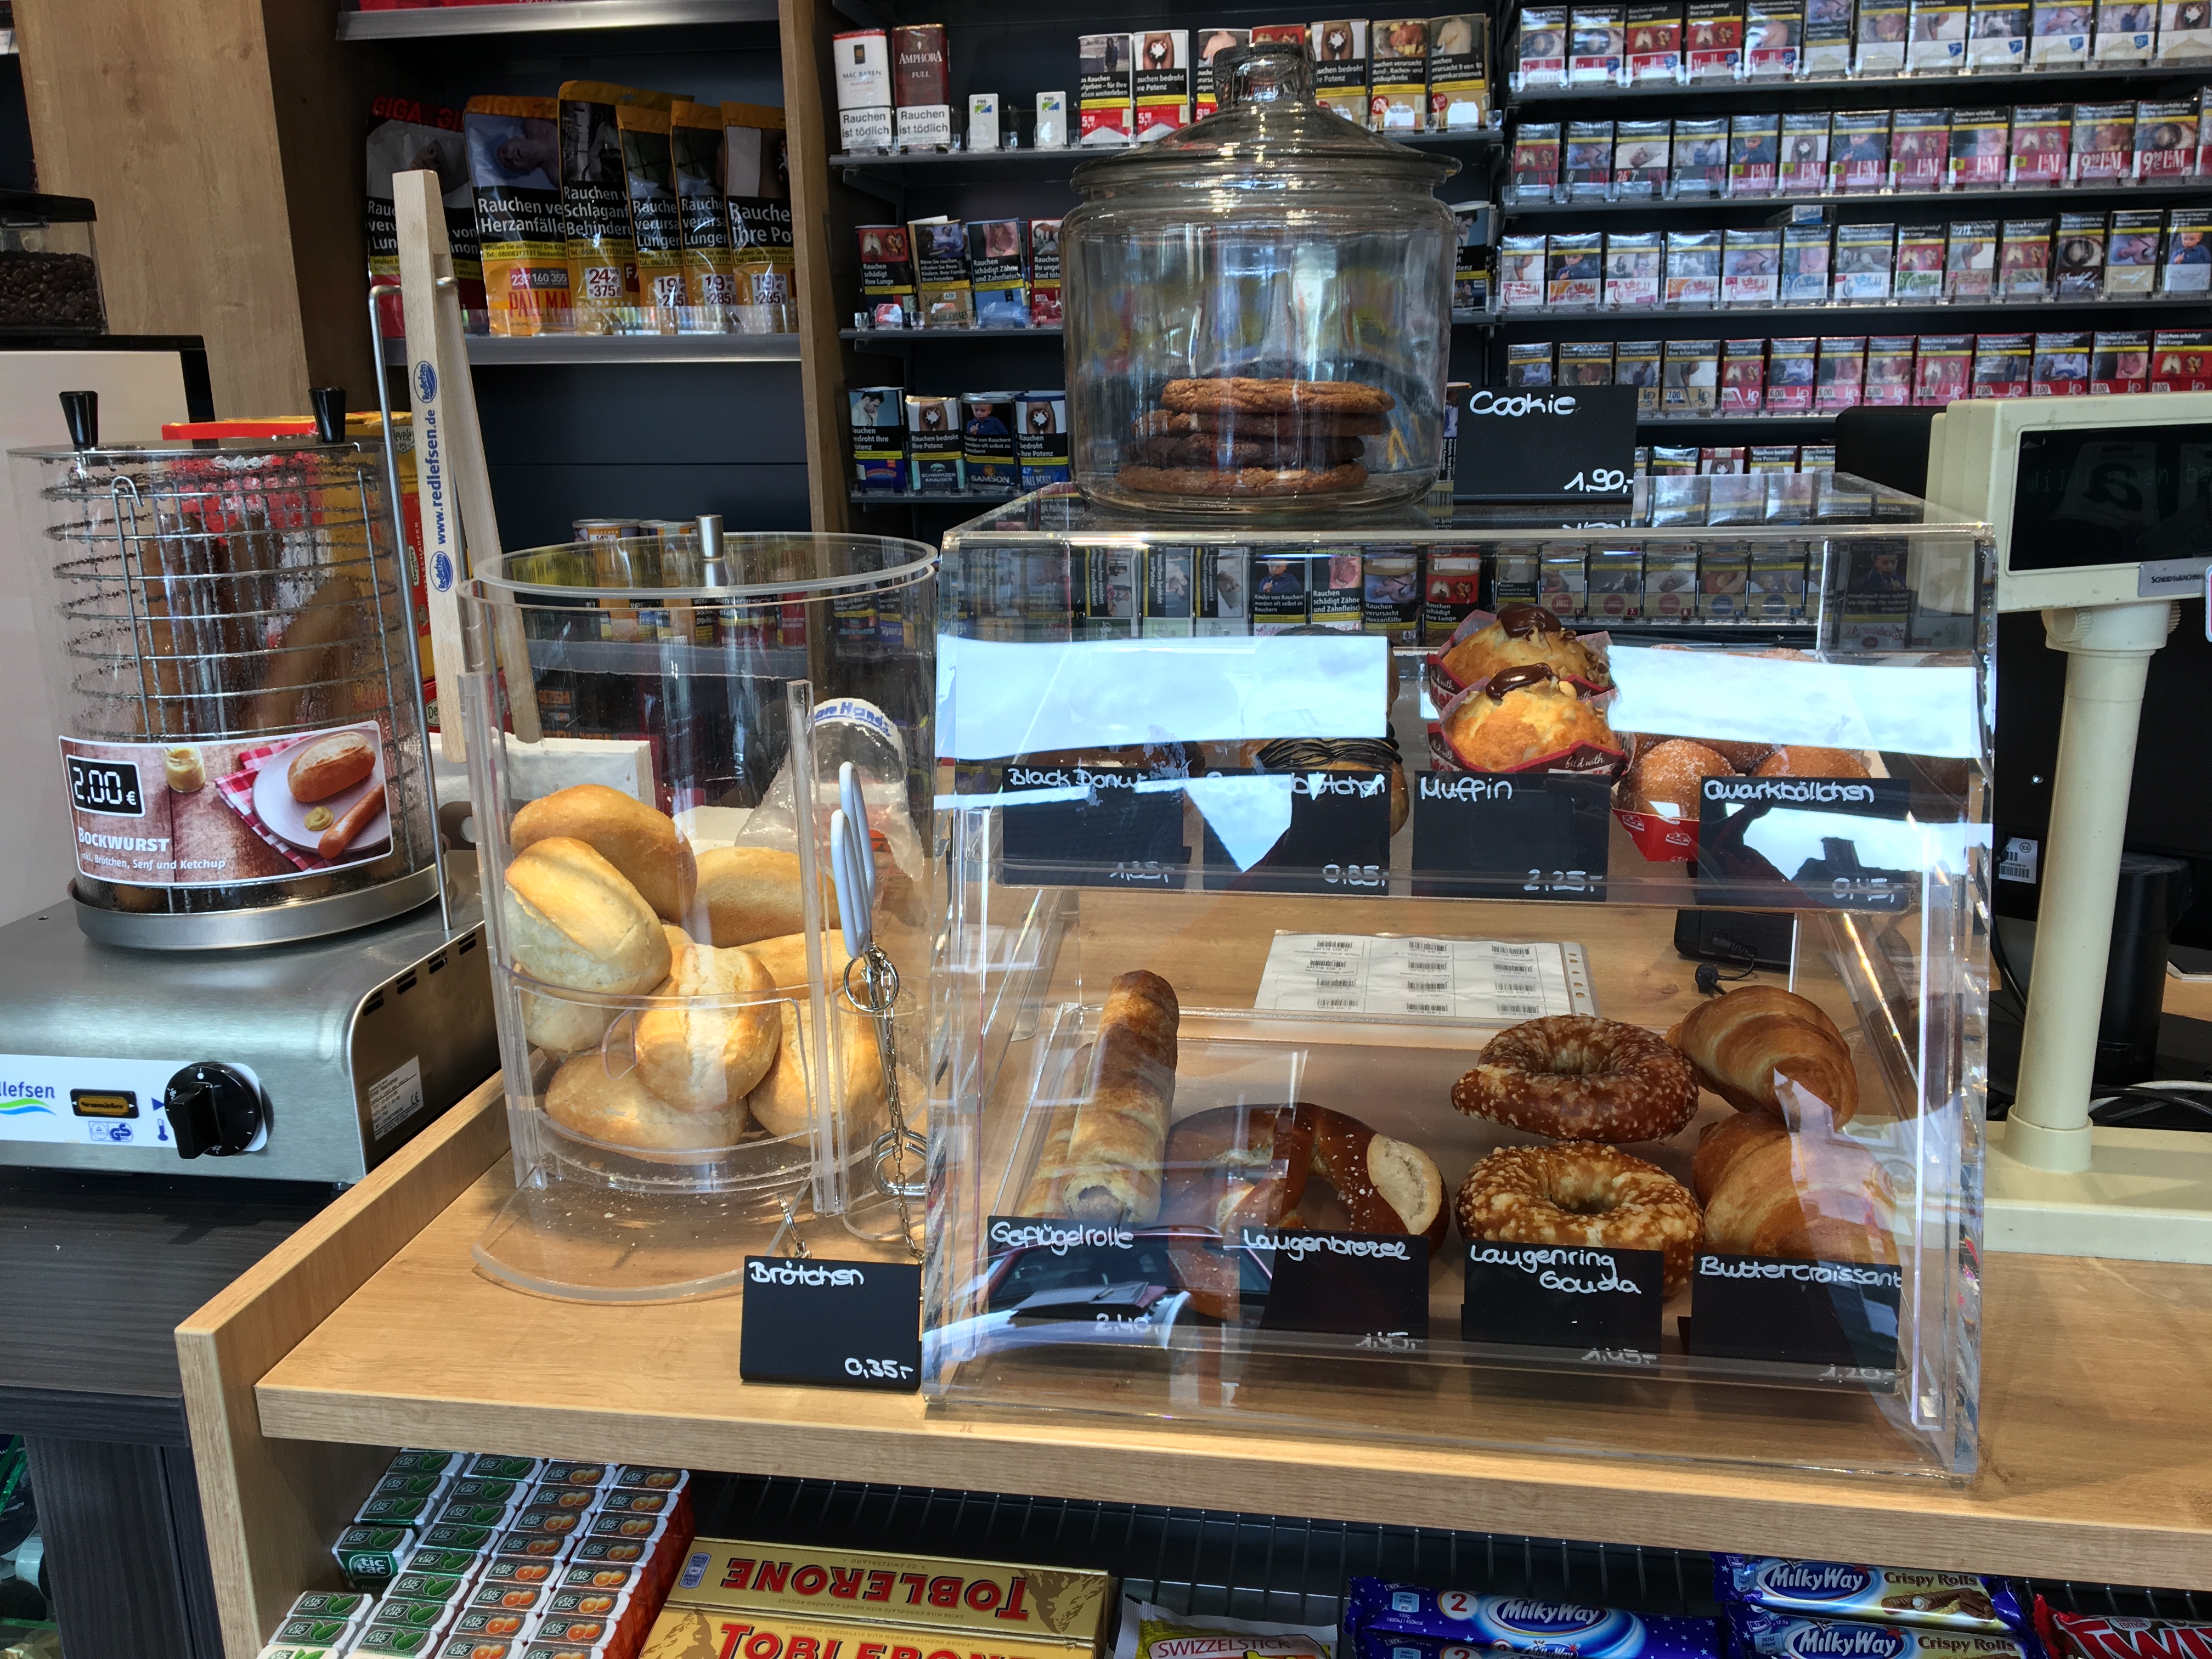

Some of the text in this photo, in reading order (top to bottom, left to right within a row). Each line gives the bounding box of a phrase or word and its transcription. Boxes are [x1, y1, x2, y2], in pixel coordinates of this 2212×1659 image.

[899, 50, 943, 65] AMPHORA
[843, 114, 886, 123] Rauchen
[901, 110, 944, 120] Rauchen
[842, 126, 889, 138] ist tödlich
[899, 123, 948, 134] ist tödlich
[564, 186, 618, 201] Rauchen
[478, 197, 541, 213] Rauchen
[564, 202, 629, 220] Schlaganf
[481, 218, 565, 234] Herzanfälle
[533, 273, 549, 283] 160
[988, 272, 1022, 281] Zahnfleisch
[1469, 391, 1577, 416] Cookie
[426, 409, 446, 545] www.redlefsen.de
[970, 475, 1009, 483] SAMSON
[1313, 590, 1340, 598] Rauchen
[73, 767, 137, 805] 2,00 €
[1008, 768, 1148, 789] Black Donut
[1420, 777, 1513, 803] Muffin
[1704, 780, 1875, 805] Quarkbällchen
[78, 826, 170, 852] BOCKWURST
[94, 856, 130, 869] Brötchen,
[133, 860, 153, 871] Senf
[156, 861, 176, 869] und
[180, 859, 225, 870] Ketchup
[990, 1221, 1135, 1257] Geflügelrolle
[1243, 1229, 1412, 1262] Laugenbrezel
[1470, 1245, 1618, 1278] Laugenring
[748, 1260, 865, 1288] Brötchen
[1699, 1255, 1902, 1289] Buttercroissant
[1539, 1270, 1643, 1295] Gouda
[357, 1565, 387, 1574] tac
[362, 1557, 385, 1566] tic
[851, 1559, 904, 1568] SWITZERLAND
[1883, 1572, 1978, 1587] Crispy Rolls
[720, 1557, 1030, 1622] TOBLERONE
[1451, 1593, 1468, 1612] 2
[824, 1629, 866, 1637] CHOCOLATE
[2118, 1621, 2147, 1631] EDITION
[1158, 1639, 1291, 1658] SWIZZELSTICK
[1918, 1636, 2016, 1652] Crispy Rolls
